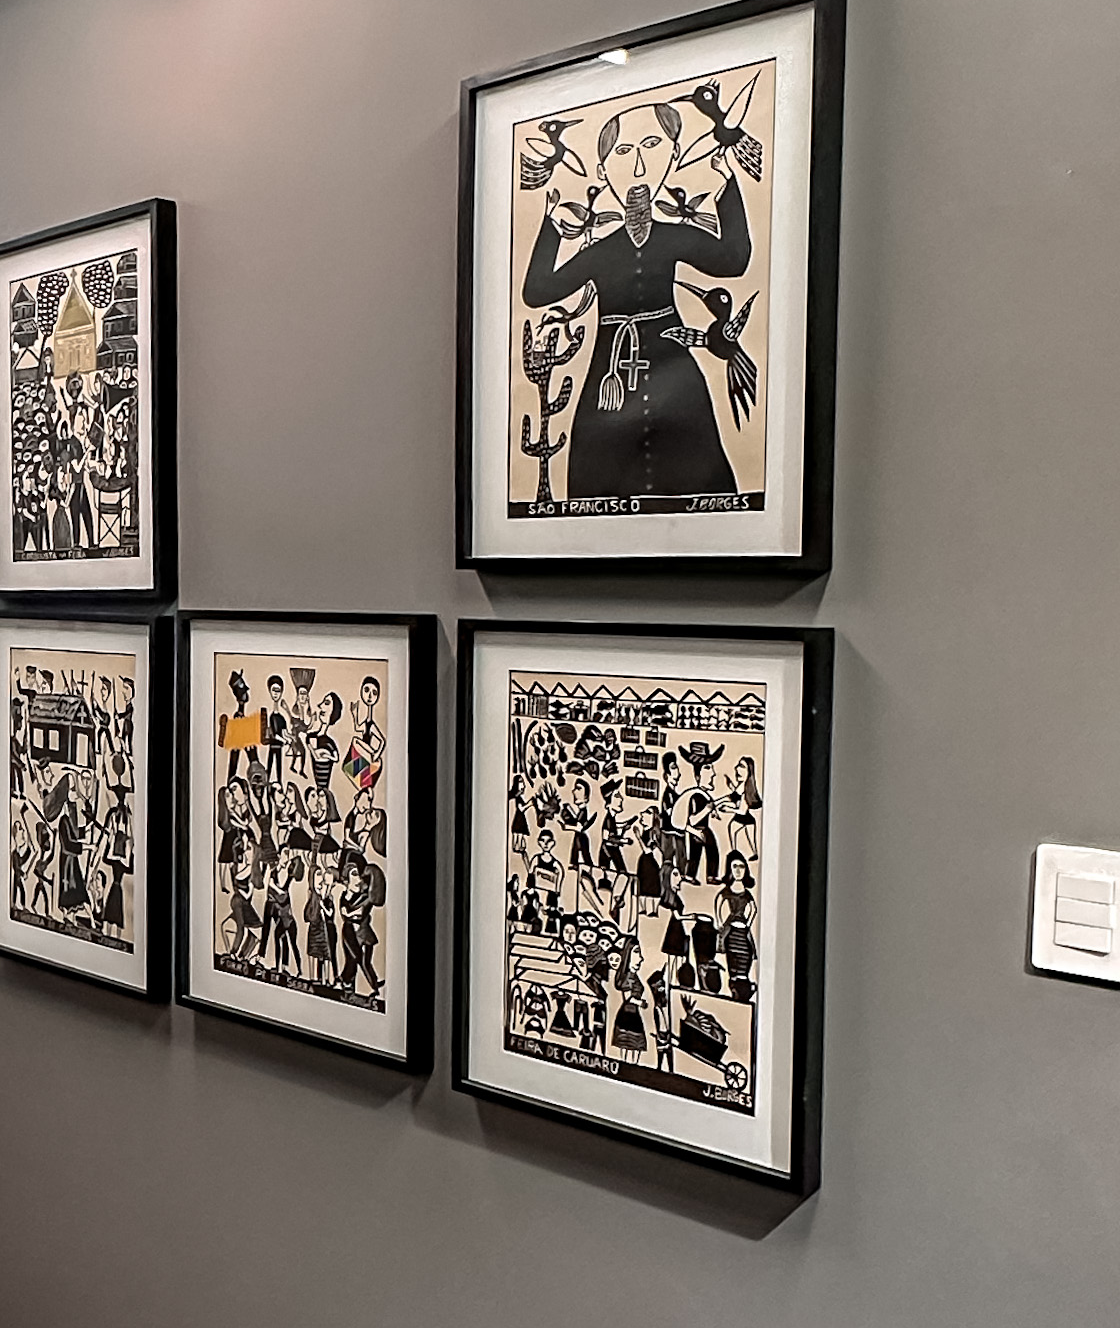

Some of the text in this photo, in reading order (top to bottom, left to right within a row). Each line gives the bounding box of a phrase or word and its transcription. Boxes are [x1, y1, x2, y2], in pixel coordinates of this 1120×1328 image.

[528, 499, 640, 515] SÃO FRANCISCO
[510, 1036, 544, 1056] FEIRA
[546, 1045, 561, 1060] DE
